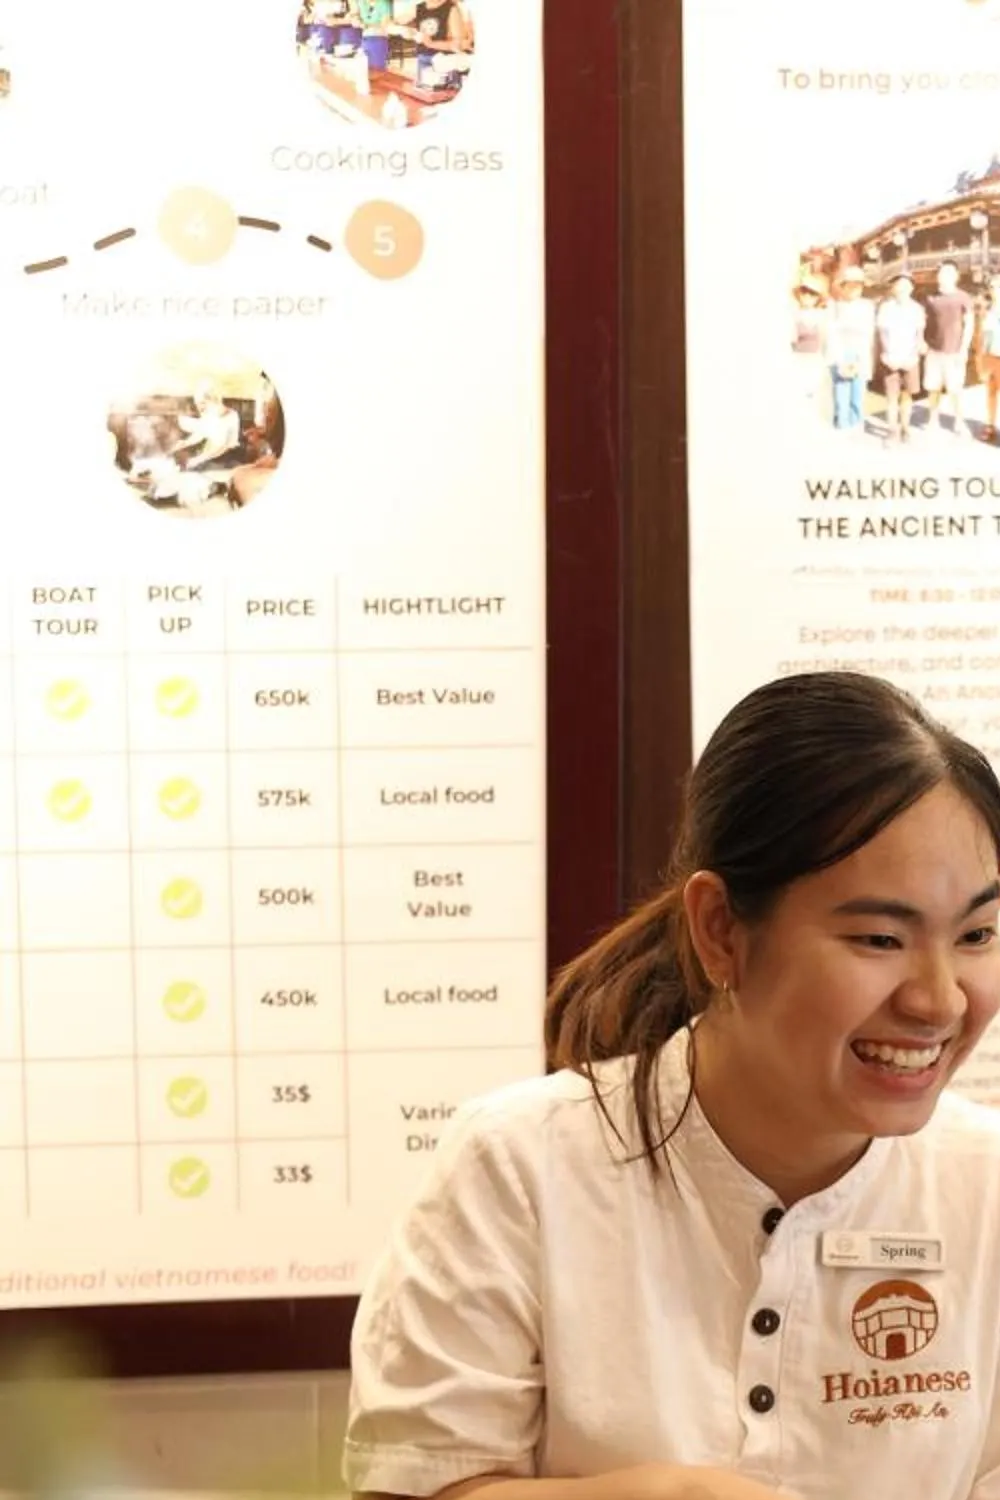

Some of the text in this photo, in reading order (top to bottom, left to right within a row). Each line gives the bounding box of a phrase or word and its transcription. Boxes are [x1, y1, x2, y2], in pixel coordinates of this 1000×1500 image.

[777, 68, 811, 91] To
[819, 68, 892, 95] bring
[270, 145, 504, 177] Cooking Class
[372, 226, 397, 257] 5
[61, 291, 330, 321] Make rice paper
[805, 477, 940, 500] WALKING
[798, 517, 851, 539] THE
[859, 515, 983, 538] ANCIENT
[31, 586, 97, 605] BOAT
[147, 585, 202, 602] PICK
[246, 599, 316, 617] PRICE
[363, 597, 506, 616] HIGHTLIGHT
[33, 618, 99, 636] TOUR
[159, 616, 193, 634] UP
[254, 689, 311, 707] 650k
[376, 687, 496, 706] Best Value
[257, 788, 312, 807] 575k
[380, 786, 495, 806] Local food
[413, 870, 464, 888] Best
[258, 887, 315, 906] 500k
[407, 900, 473, 918] Value
[259, 989, 318, 1007] 450k
[384, 986, 499, 1005] Local food
[271, 1085, 312, 1104] 35$
[272, 1165, 314, 1184] 33$
[880, 1244, 927, 1261] Spring
[115, 1265, 279, 1290] vietnamese
[821, 1368, 972, 1404] Hoianese
